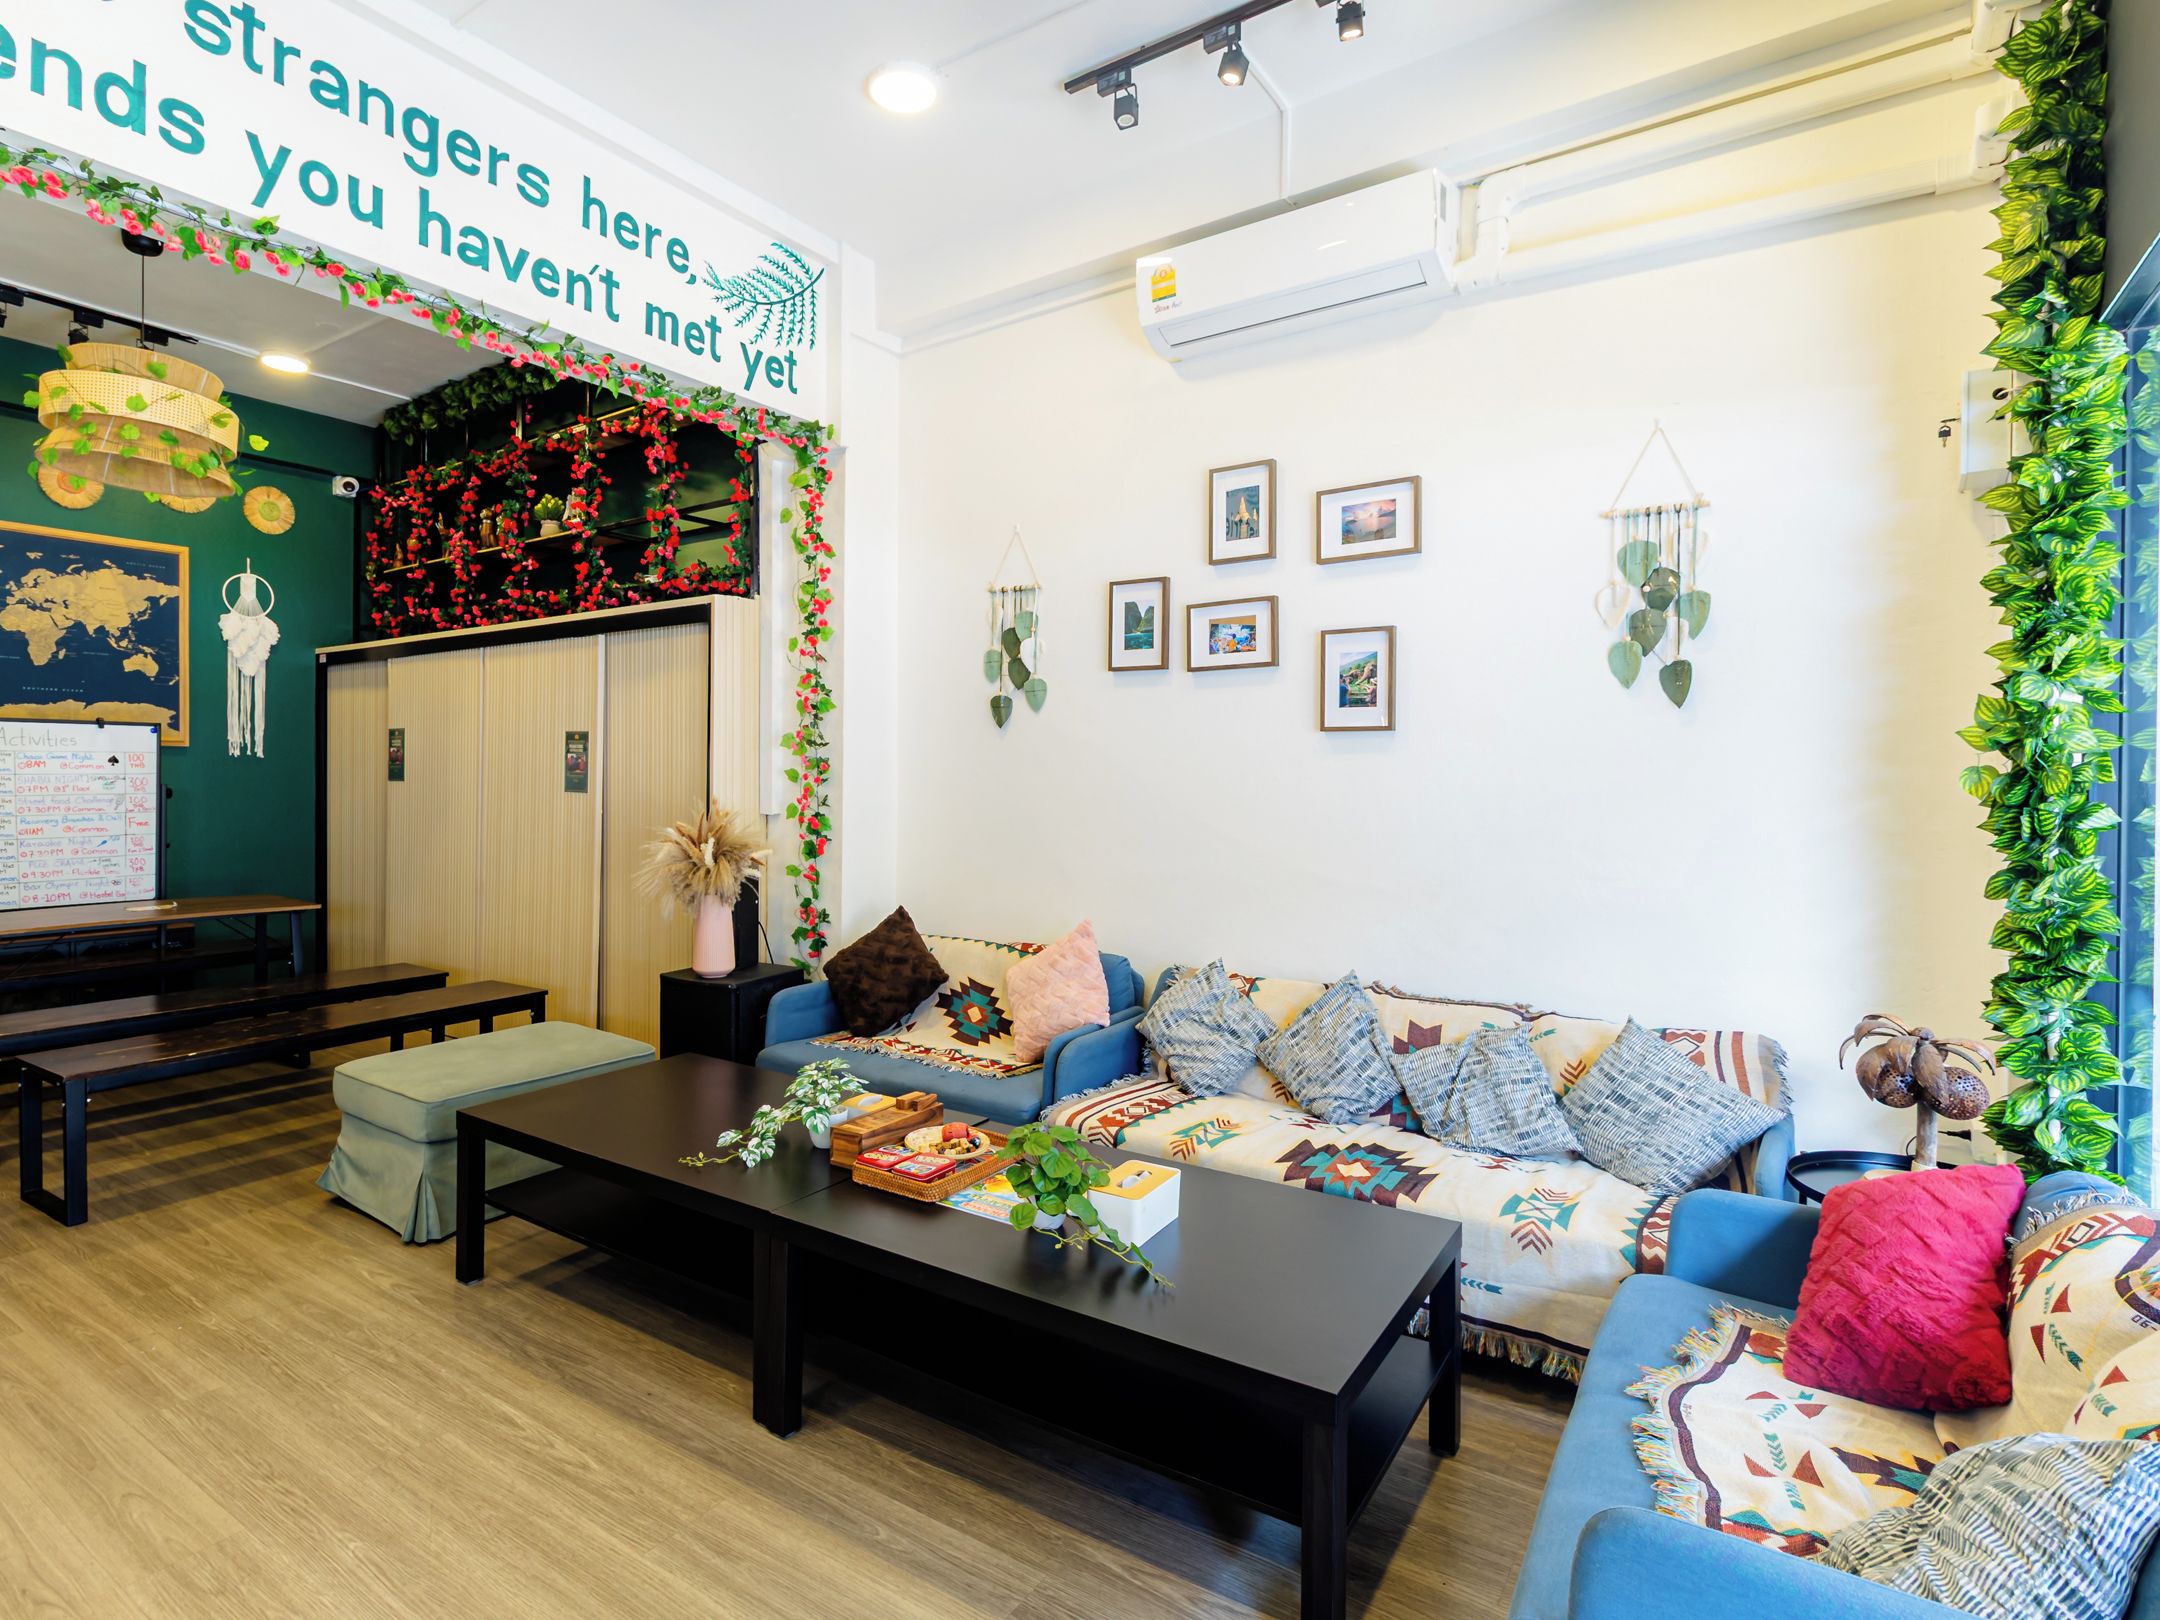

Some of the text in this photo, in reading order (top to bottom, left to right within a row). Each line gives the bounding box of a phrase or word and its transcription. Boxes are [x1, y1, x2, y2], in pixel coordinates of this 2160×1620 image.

[184, 0, 697, 285] strangers here,
[245, 130, 384, 230] you
[418, 186, 620, 322] haven't
[645, 301, 722, 363] met
[740, 341, 798, 395] yet
[0, 727, 78, 748] Activities
[128, 754, 145, 763] 100
